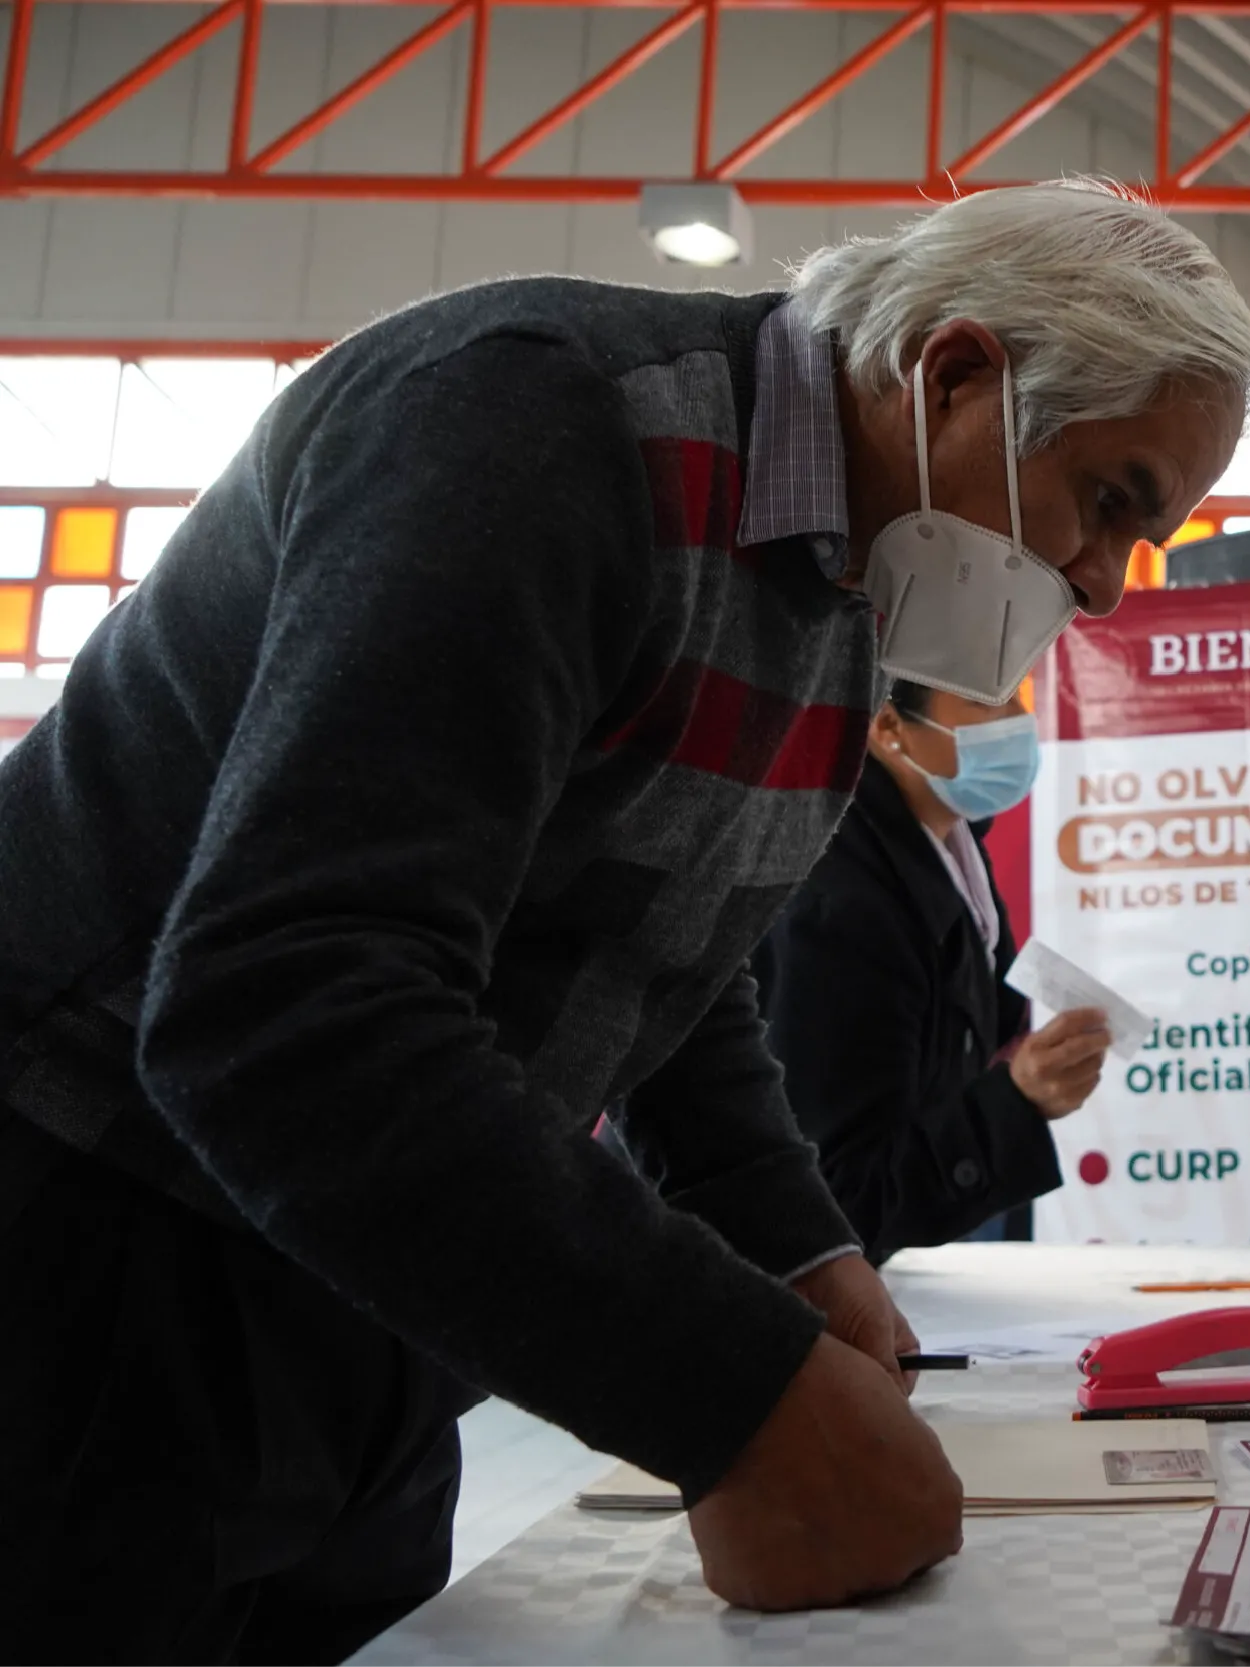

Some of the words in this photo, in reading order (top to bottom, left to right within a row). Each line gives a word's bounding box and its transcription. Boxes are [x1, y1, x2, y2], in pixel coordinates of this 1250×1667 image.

[957, 560, 972, 586] N95
[1078, 772, 1142, 808] NO
[1078, 886, 1111, 911] NI
[1121, 883, 1184, 909] LOS
[1195, 880, 1239, 905] DE
[1126, 1148, 1240, 1182] CURP
